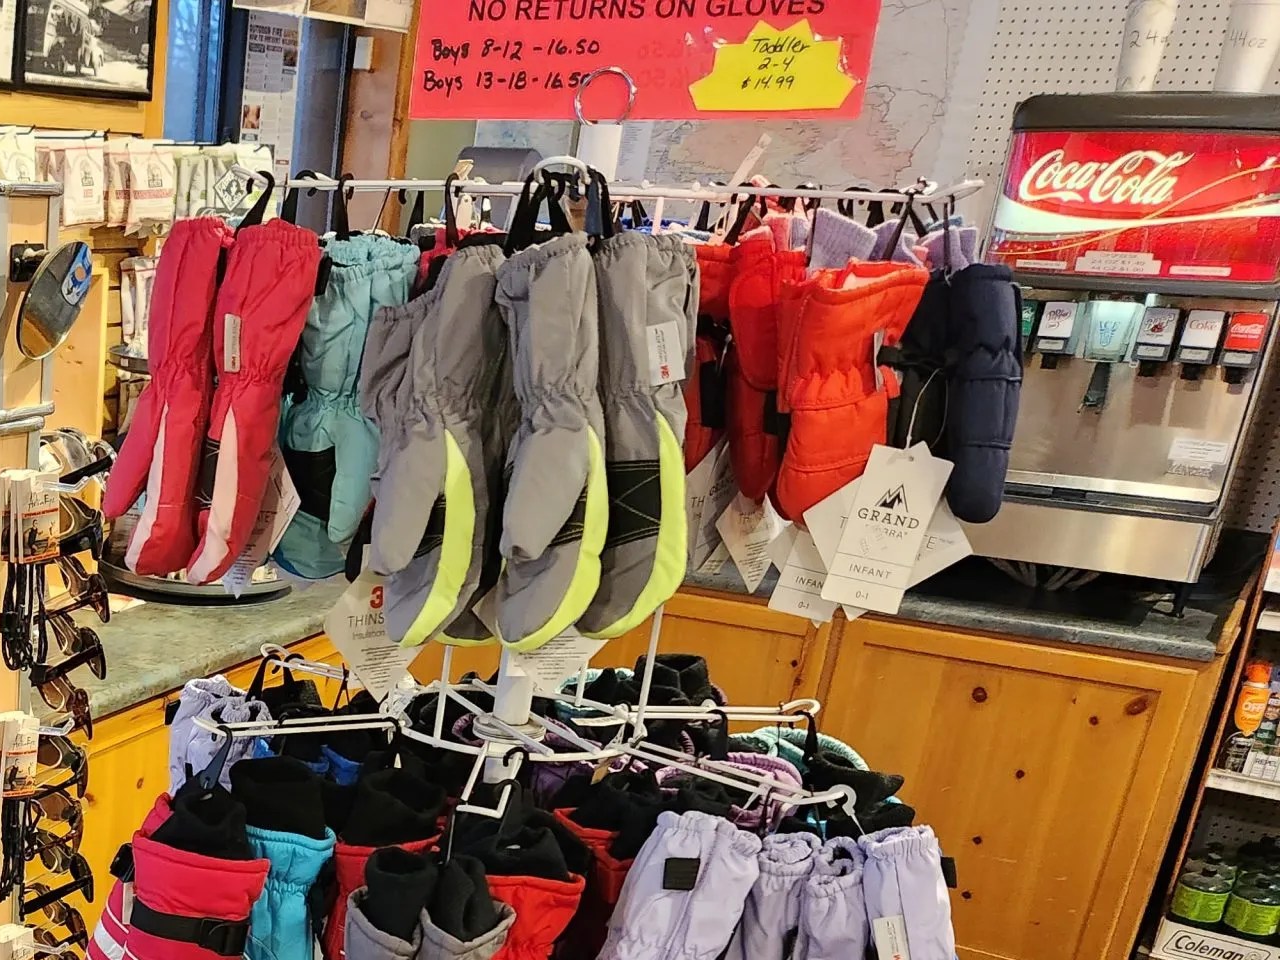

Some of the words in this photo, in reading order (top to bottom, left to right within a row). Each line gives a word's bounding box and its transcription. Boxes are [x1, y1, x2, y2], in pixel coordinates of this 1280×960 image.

[469, 0, 507, 21] NO
[516, 0, 645, 21] RETURNS
[655, 0, 696, 18] ON
[705, 0, 826, 17] GLOVES
[431, 39, 470, 66] Boys
[751, 36, 811, 55] Toddler
[758, 57, 795, 71] 2-4
[423, 70, 463, 98] Boys
[1019, 149, 1196, 205] Coca-Cola
[857, 507, 920, 530] GRAND
[849, 563, 894, 580] INFANT
[795, 575, 825, 590] INFAN
